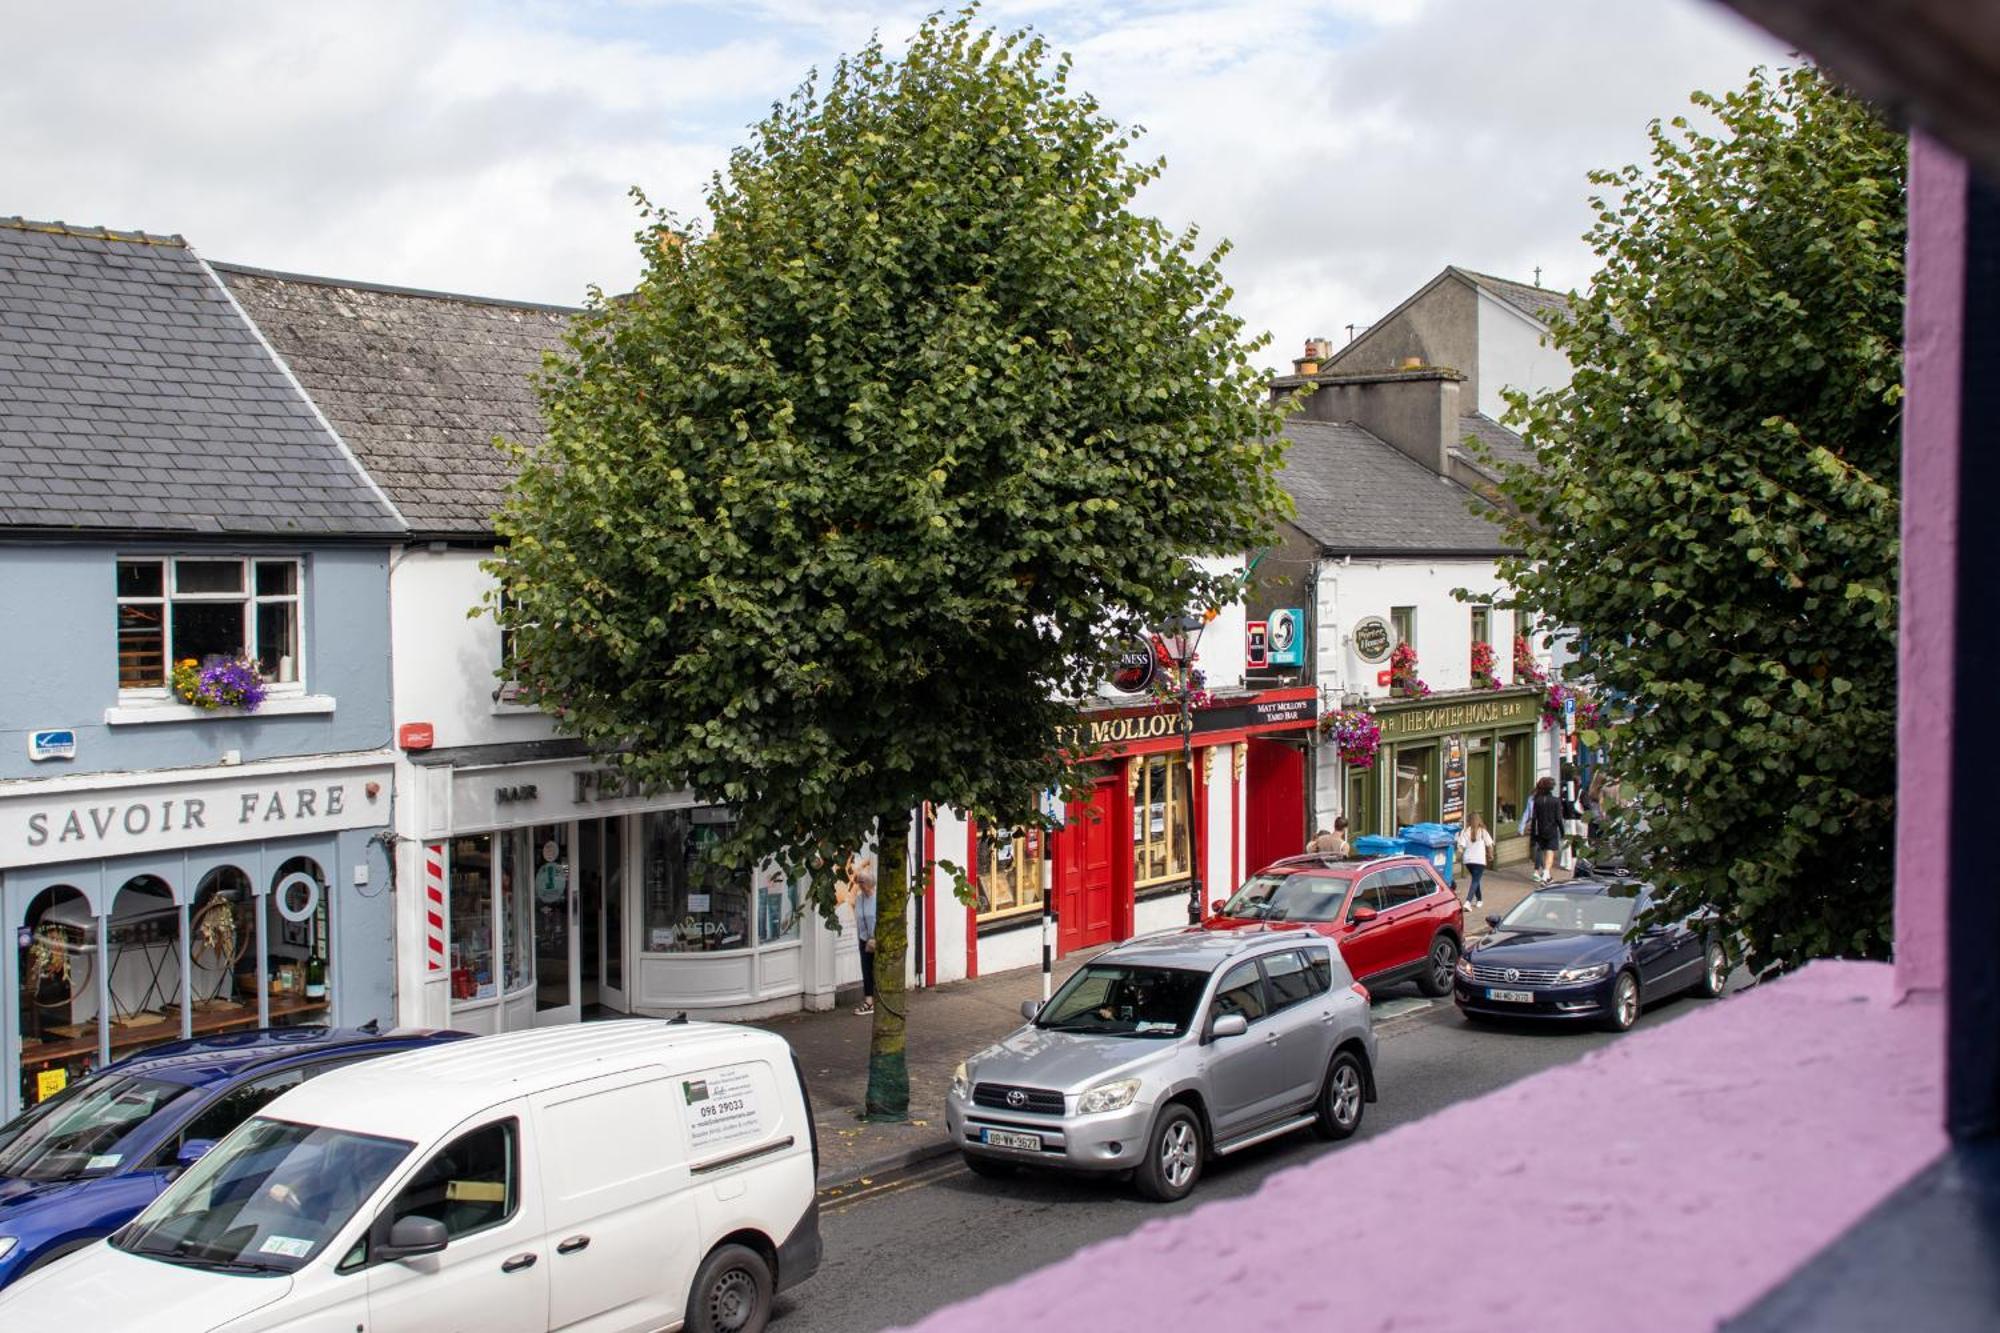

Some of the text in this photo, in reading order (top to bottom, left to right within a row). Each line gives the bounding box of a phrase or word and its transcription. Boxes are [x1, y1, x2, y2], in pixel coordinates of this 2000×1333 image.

[1285, 711, 1299, 721] BAR
[1400, 711, 1423, 733] THE
[1424, 705, 1464, 730] PORTER
[1465, 702, 1498, 725] HOUSE
[1502, 703, 1521, 717] BAR
[27, 785, 345, 847] SAVOIR FARE
[700, 1099, 744, 1118] 098 29033
